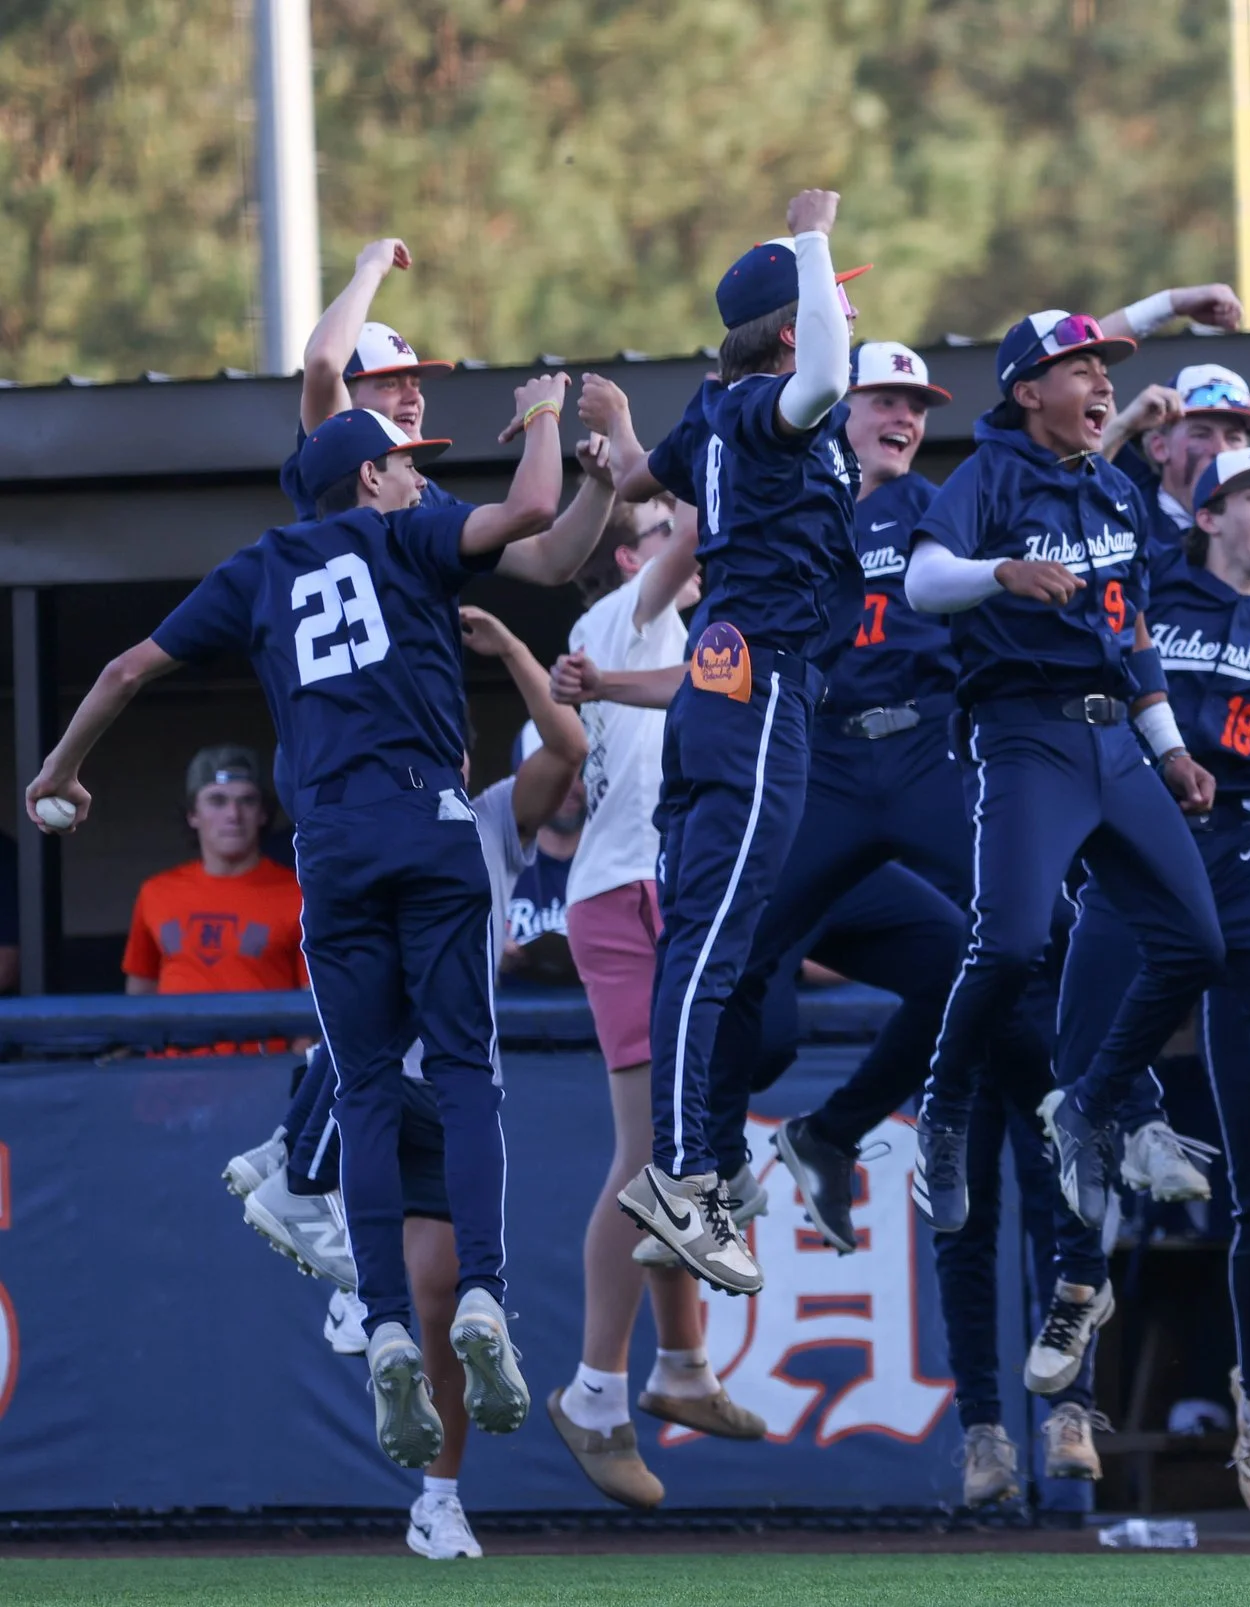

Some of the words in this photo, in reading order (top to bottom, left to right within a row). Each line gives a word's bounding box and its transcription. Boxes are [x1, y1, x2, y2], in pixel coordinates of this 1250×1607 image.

[891, 354, 915, 375] H
[1024, 523, 1137, 566] Habersham
[1104, 580, 1126, 634] 9
